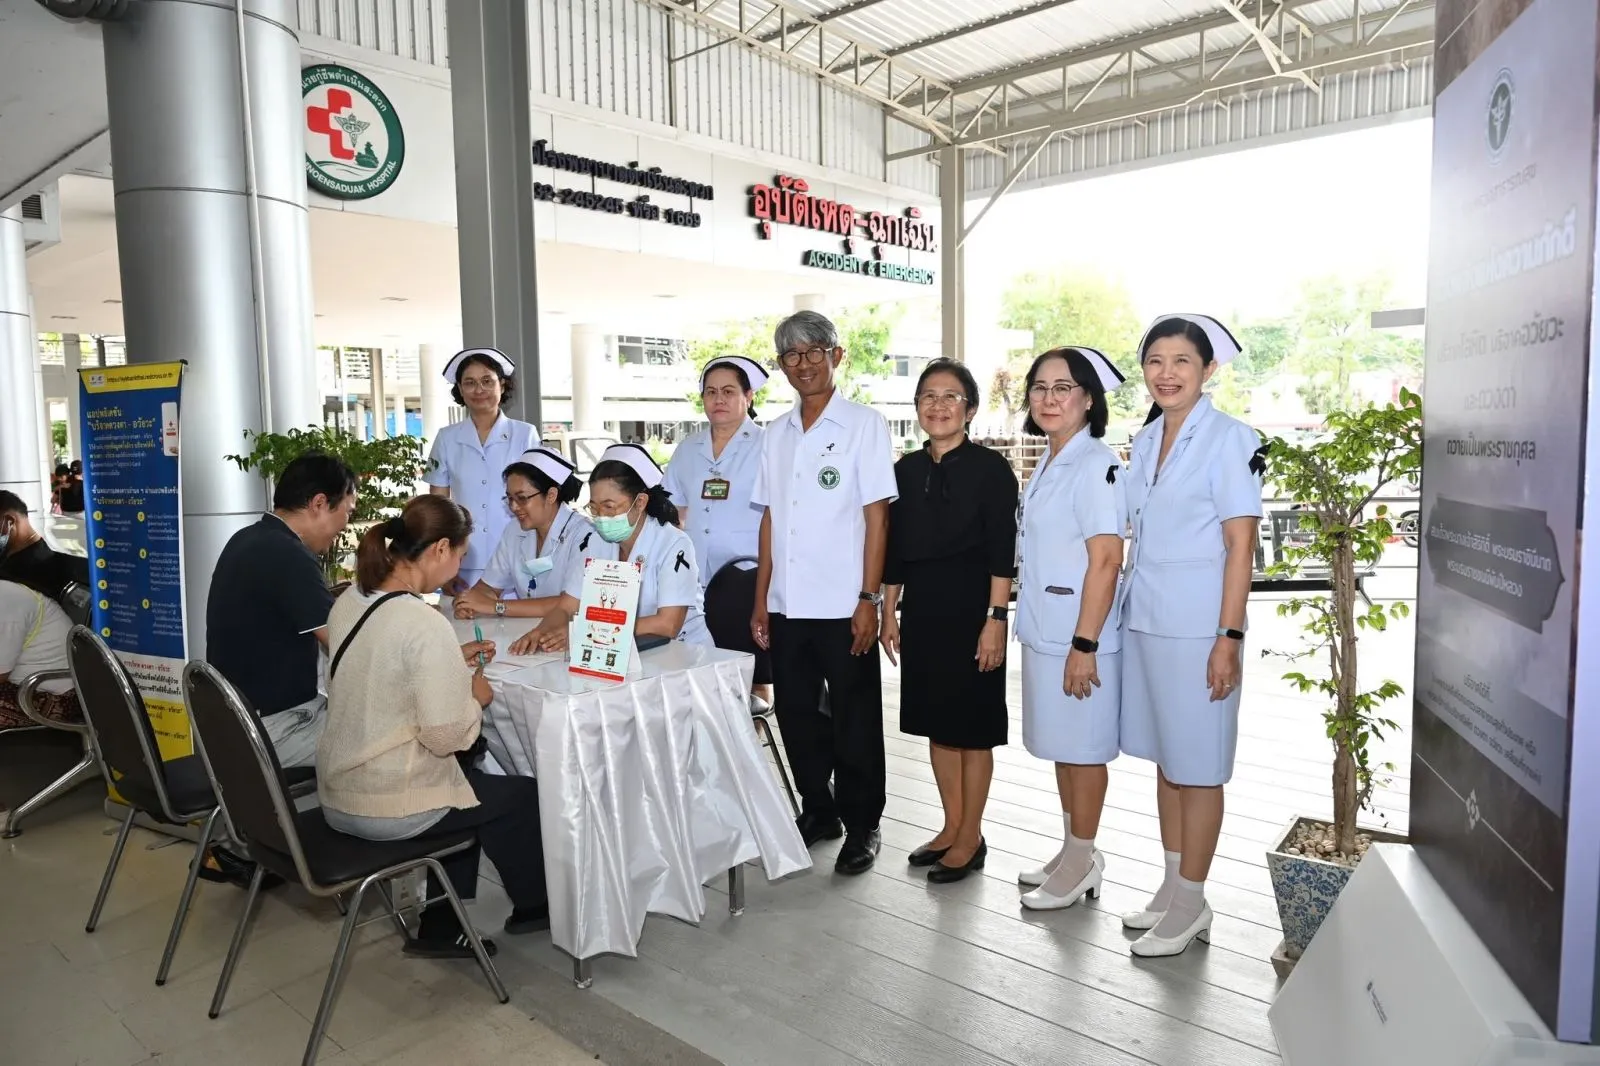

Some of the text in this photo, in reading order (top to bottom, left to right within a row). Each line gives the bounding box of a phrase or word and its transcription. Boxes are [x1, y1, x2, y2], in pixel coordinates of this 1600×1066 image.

[306, 160, 397, 193] NOENSADUAK HOSPITAL
[664, 208, 701, 228] 1669
[805, 249, 936, 286] ACCIDENT & EMERGENCY
[1447, 434, 1537, 467] ถวายเป็นพระราชกุศล
